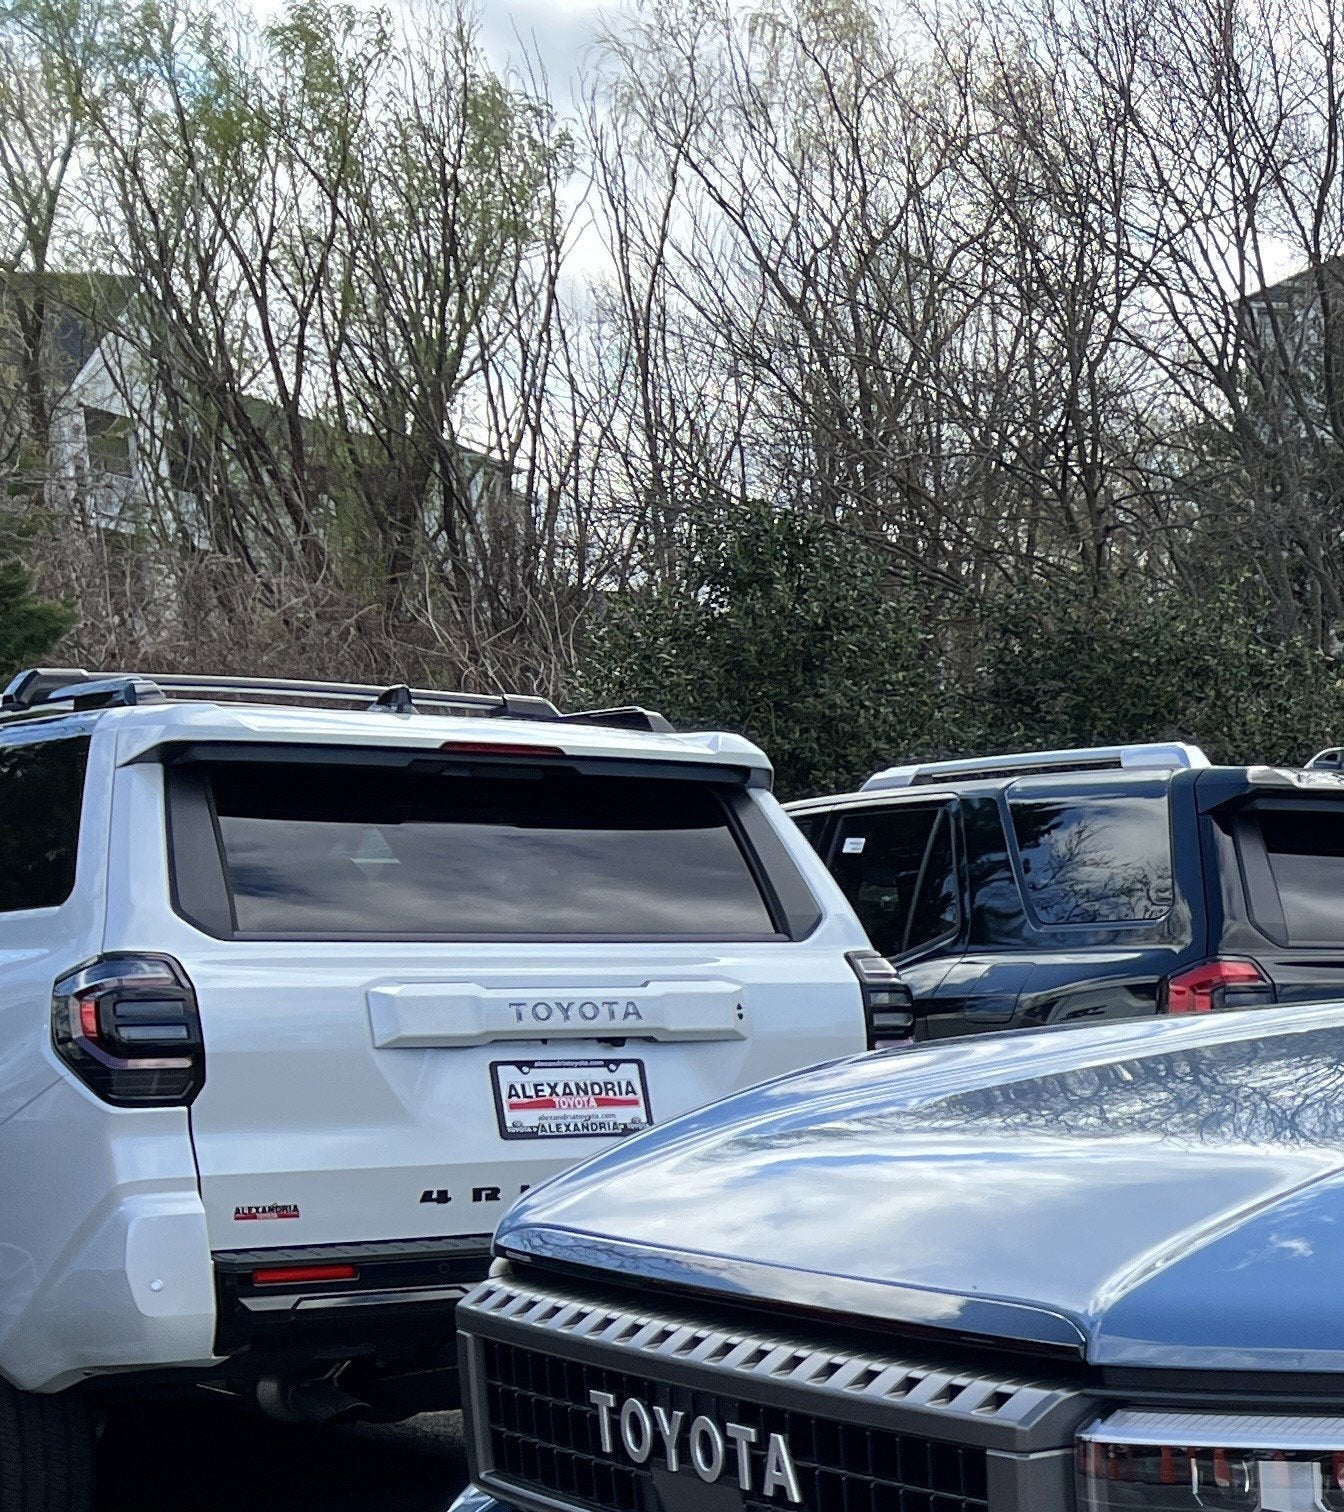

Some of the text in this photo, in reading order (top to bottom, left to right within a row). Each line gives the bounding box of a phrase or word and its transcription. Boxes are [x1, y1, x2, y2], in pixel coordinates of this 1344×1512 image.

[509, 1000, 643, 1023] TOYOTA
[507, 1080, 637, 1099] ALEXANDRIA
[553, 1097, 597, 1109] TOYOTA
[539, 1121, 620, 1134] ALEXANDRIA
[235, 1204, 299, 1215] ALEXANDRIA
[589, 1389, 801, 1503] TOYOTA
